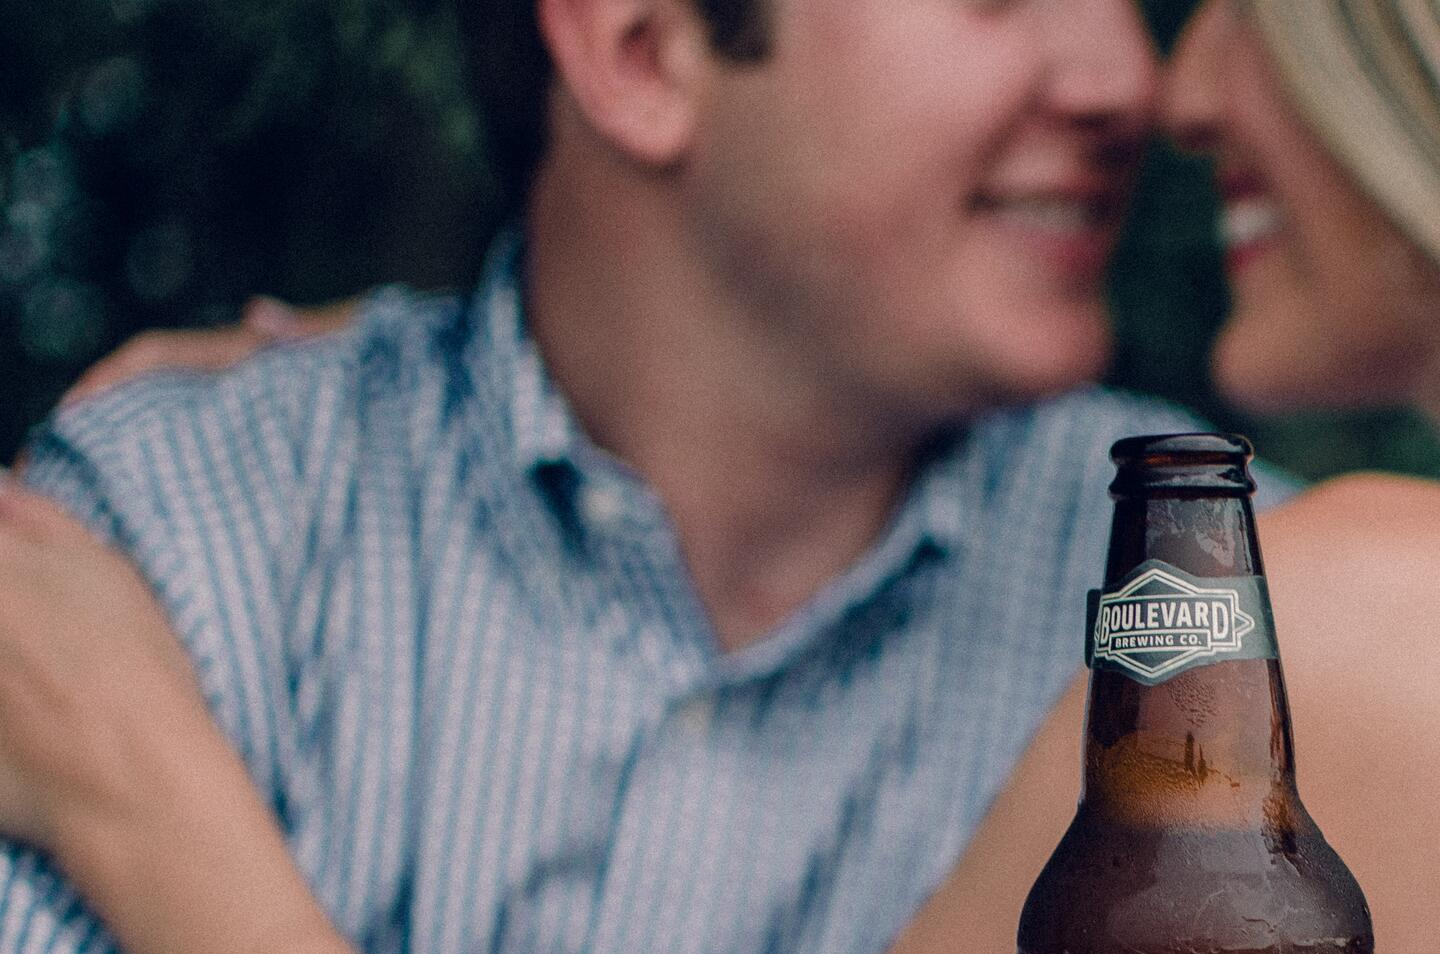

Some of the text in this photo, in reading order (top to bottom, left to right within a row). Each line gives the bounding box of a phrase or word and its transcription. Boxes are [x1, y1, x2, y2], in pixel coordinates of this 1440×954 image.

[1099, 600, 1228, 644] BOULEVARD
[1115, 632, 1202, 649] BREWING CO.
